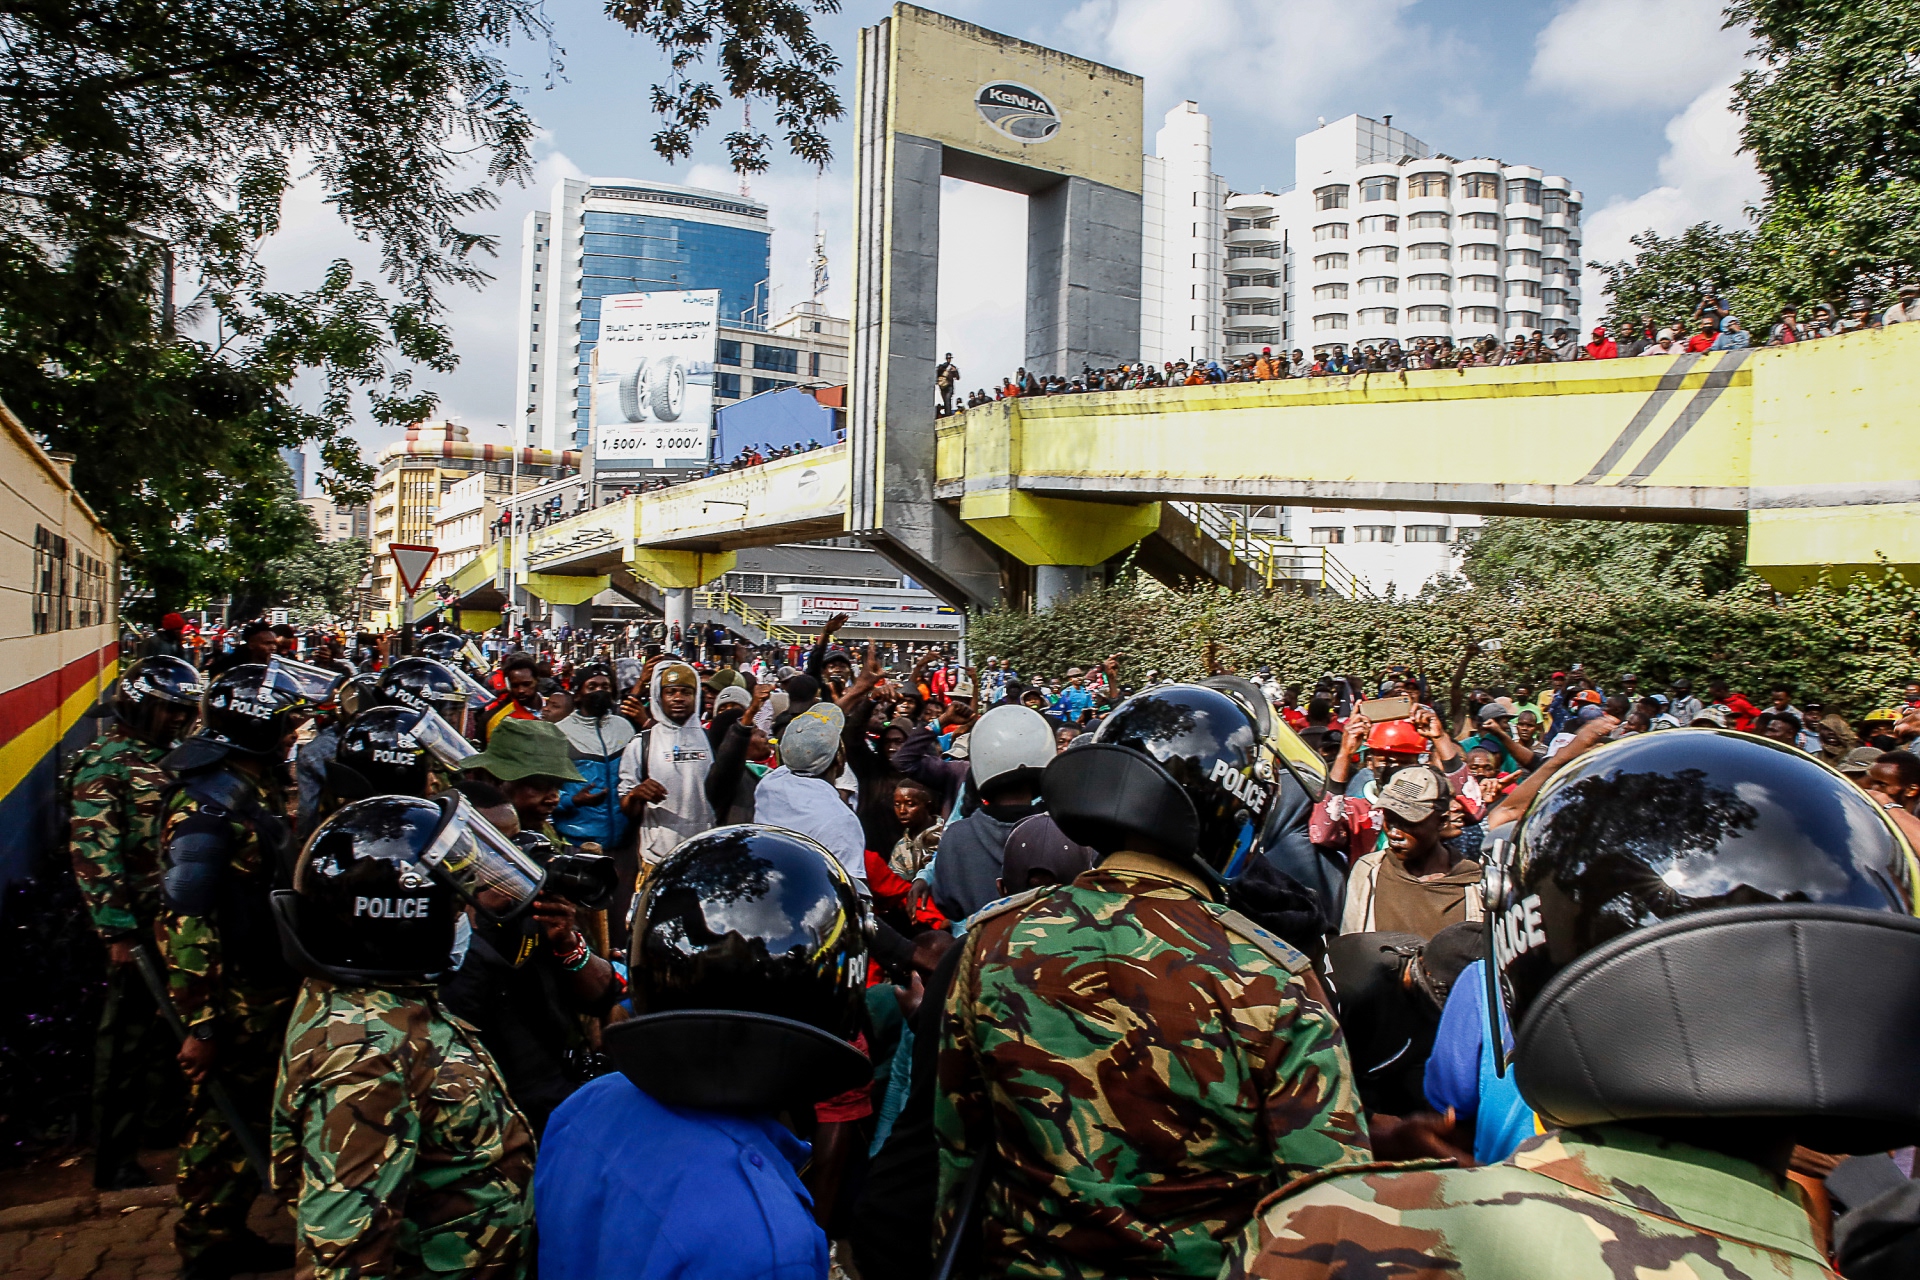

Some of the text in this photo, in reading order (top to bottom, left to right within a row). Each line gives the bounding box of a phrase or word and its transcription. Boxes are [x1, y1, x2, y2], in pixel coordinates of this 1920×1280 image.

[606, 321, 711, 332] BUILT TO PERFORM
[606, 331, 708, 342] MADE TO LAST
[229, 699, 273, 720] POLICE
[373, 749, 416, 766] POLICE
[1209, 758, 1267, 814] POLICE
[353, 896, 430, 918] POLICE
